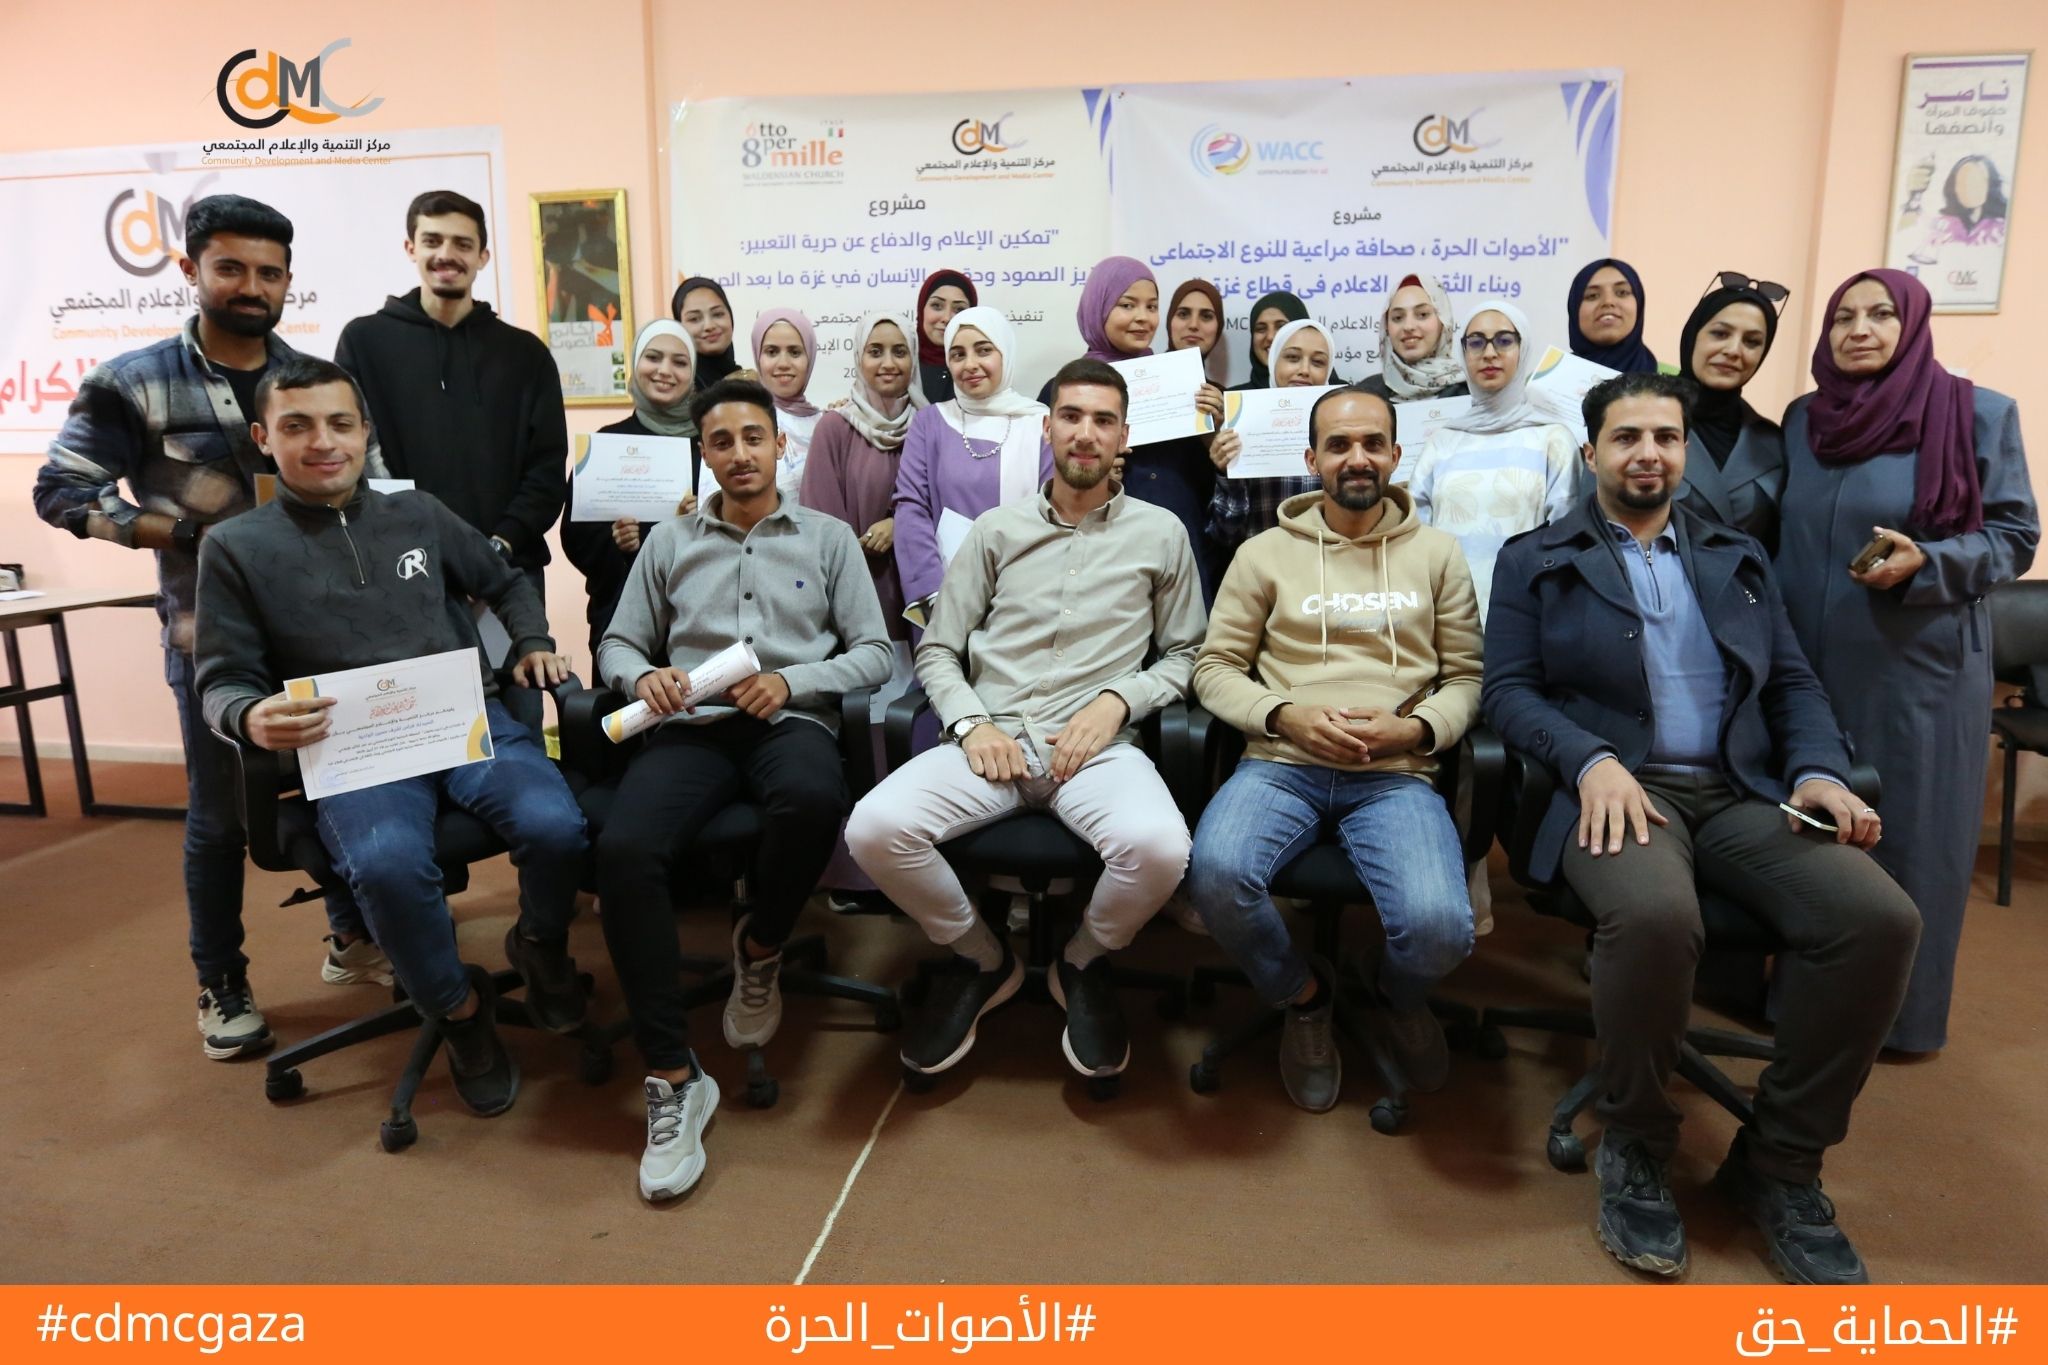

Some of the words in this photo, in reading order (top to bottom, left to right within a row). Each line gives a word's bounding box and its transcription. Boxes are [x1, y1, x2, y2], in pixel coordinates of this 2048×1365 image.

[742, 138, 762, 168] 8
[771, 140, 844, 167] mille
[1257, 141, 1325, 160] WACC
[916, 160, 961, 174] المجتمعي
[963, 158, 998, 171] والإعلام
[1000, 157, 1031, 170] التنمية
[1033, 156, 1056, 168] مركز
[1372, 162, 1424, 178] المجتمعي
[1426, 160, 1466, 174] والإعلام
[1469, 158, 1505, 173] التنمية
[1508, 158, 1533, 171] مركز
[868, 193, 926, 217] مشروع
[1333, 206, 1381, 225] مشروع
[740, 234, 796, 255] التعبير:
[801, 234, 837, 252] حرية
[843, 234, 865, 250] عن
[870, 231, 931, 253] والدفاع
[937, 230, 994, 251] الإعلام
[999, 229, 1059, 250] "تمكين
[1355, 237, 1415, 256] صحافة
[1431, 237, 1478, 261] الحرة
[1483, 234, 1569, 261] "الأصوات
[1240, 240, 1288, 263] للنوع
[1292, 240, 1350, 262] مراعية
[746, 273, 772, 290] بعد
[777, 271, 795, 285] ما
[800, 270, 827, 289] غزة
[832, 269, 861, 288] في
[867, 268, 926, 288] الإنسان
[1001, 266, 1065, 287] الصمود
[1330, 275, 1388, 298] الاعلام
[1477, 275, 1521, 298] وبناء
[1246, 274, 1293, 300] قطاع
[50, 289, 132, 324] المجتمعي
[1302, 592, 1419, 615] CHOSEN
